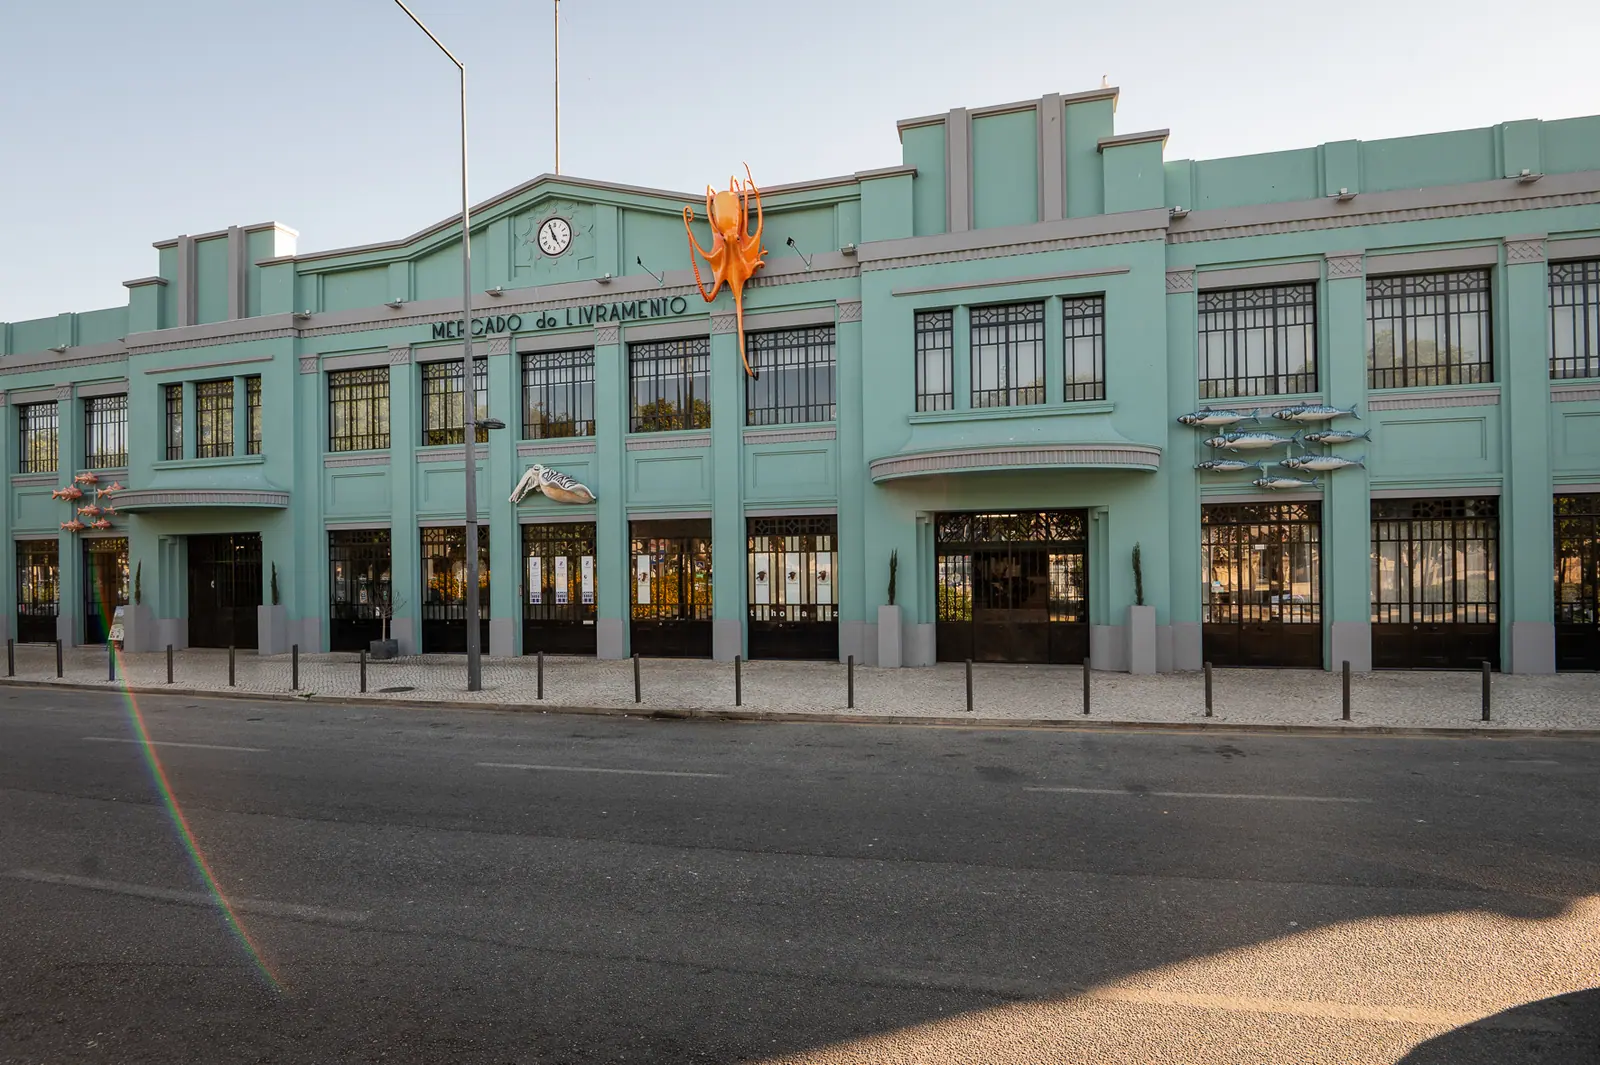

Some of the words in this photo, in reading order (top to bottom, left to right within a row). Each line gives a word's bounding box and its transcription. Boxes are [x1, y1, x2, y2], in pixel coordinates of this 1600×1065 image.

[432, 314, 522, 340] MERCADO
[536, 311, 557, 329] do
[566, 297, 687, 326] LIVRAMENTO
